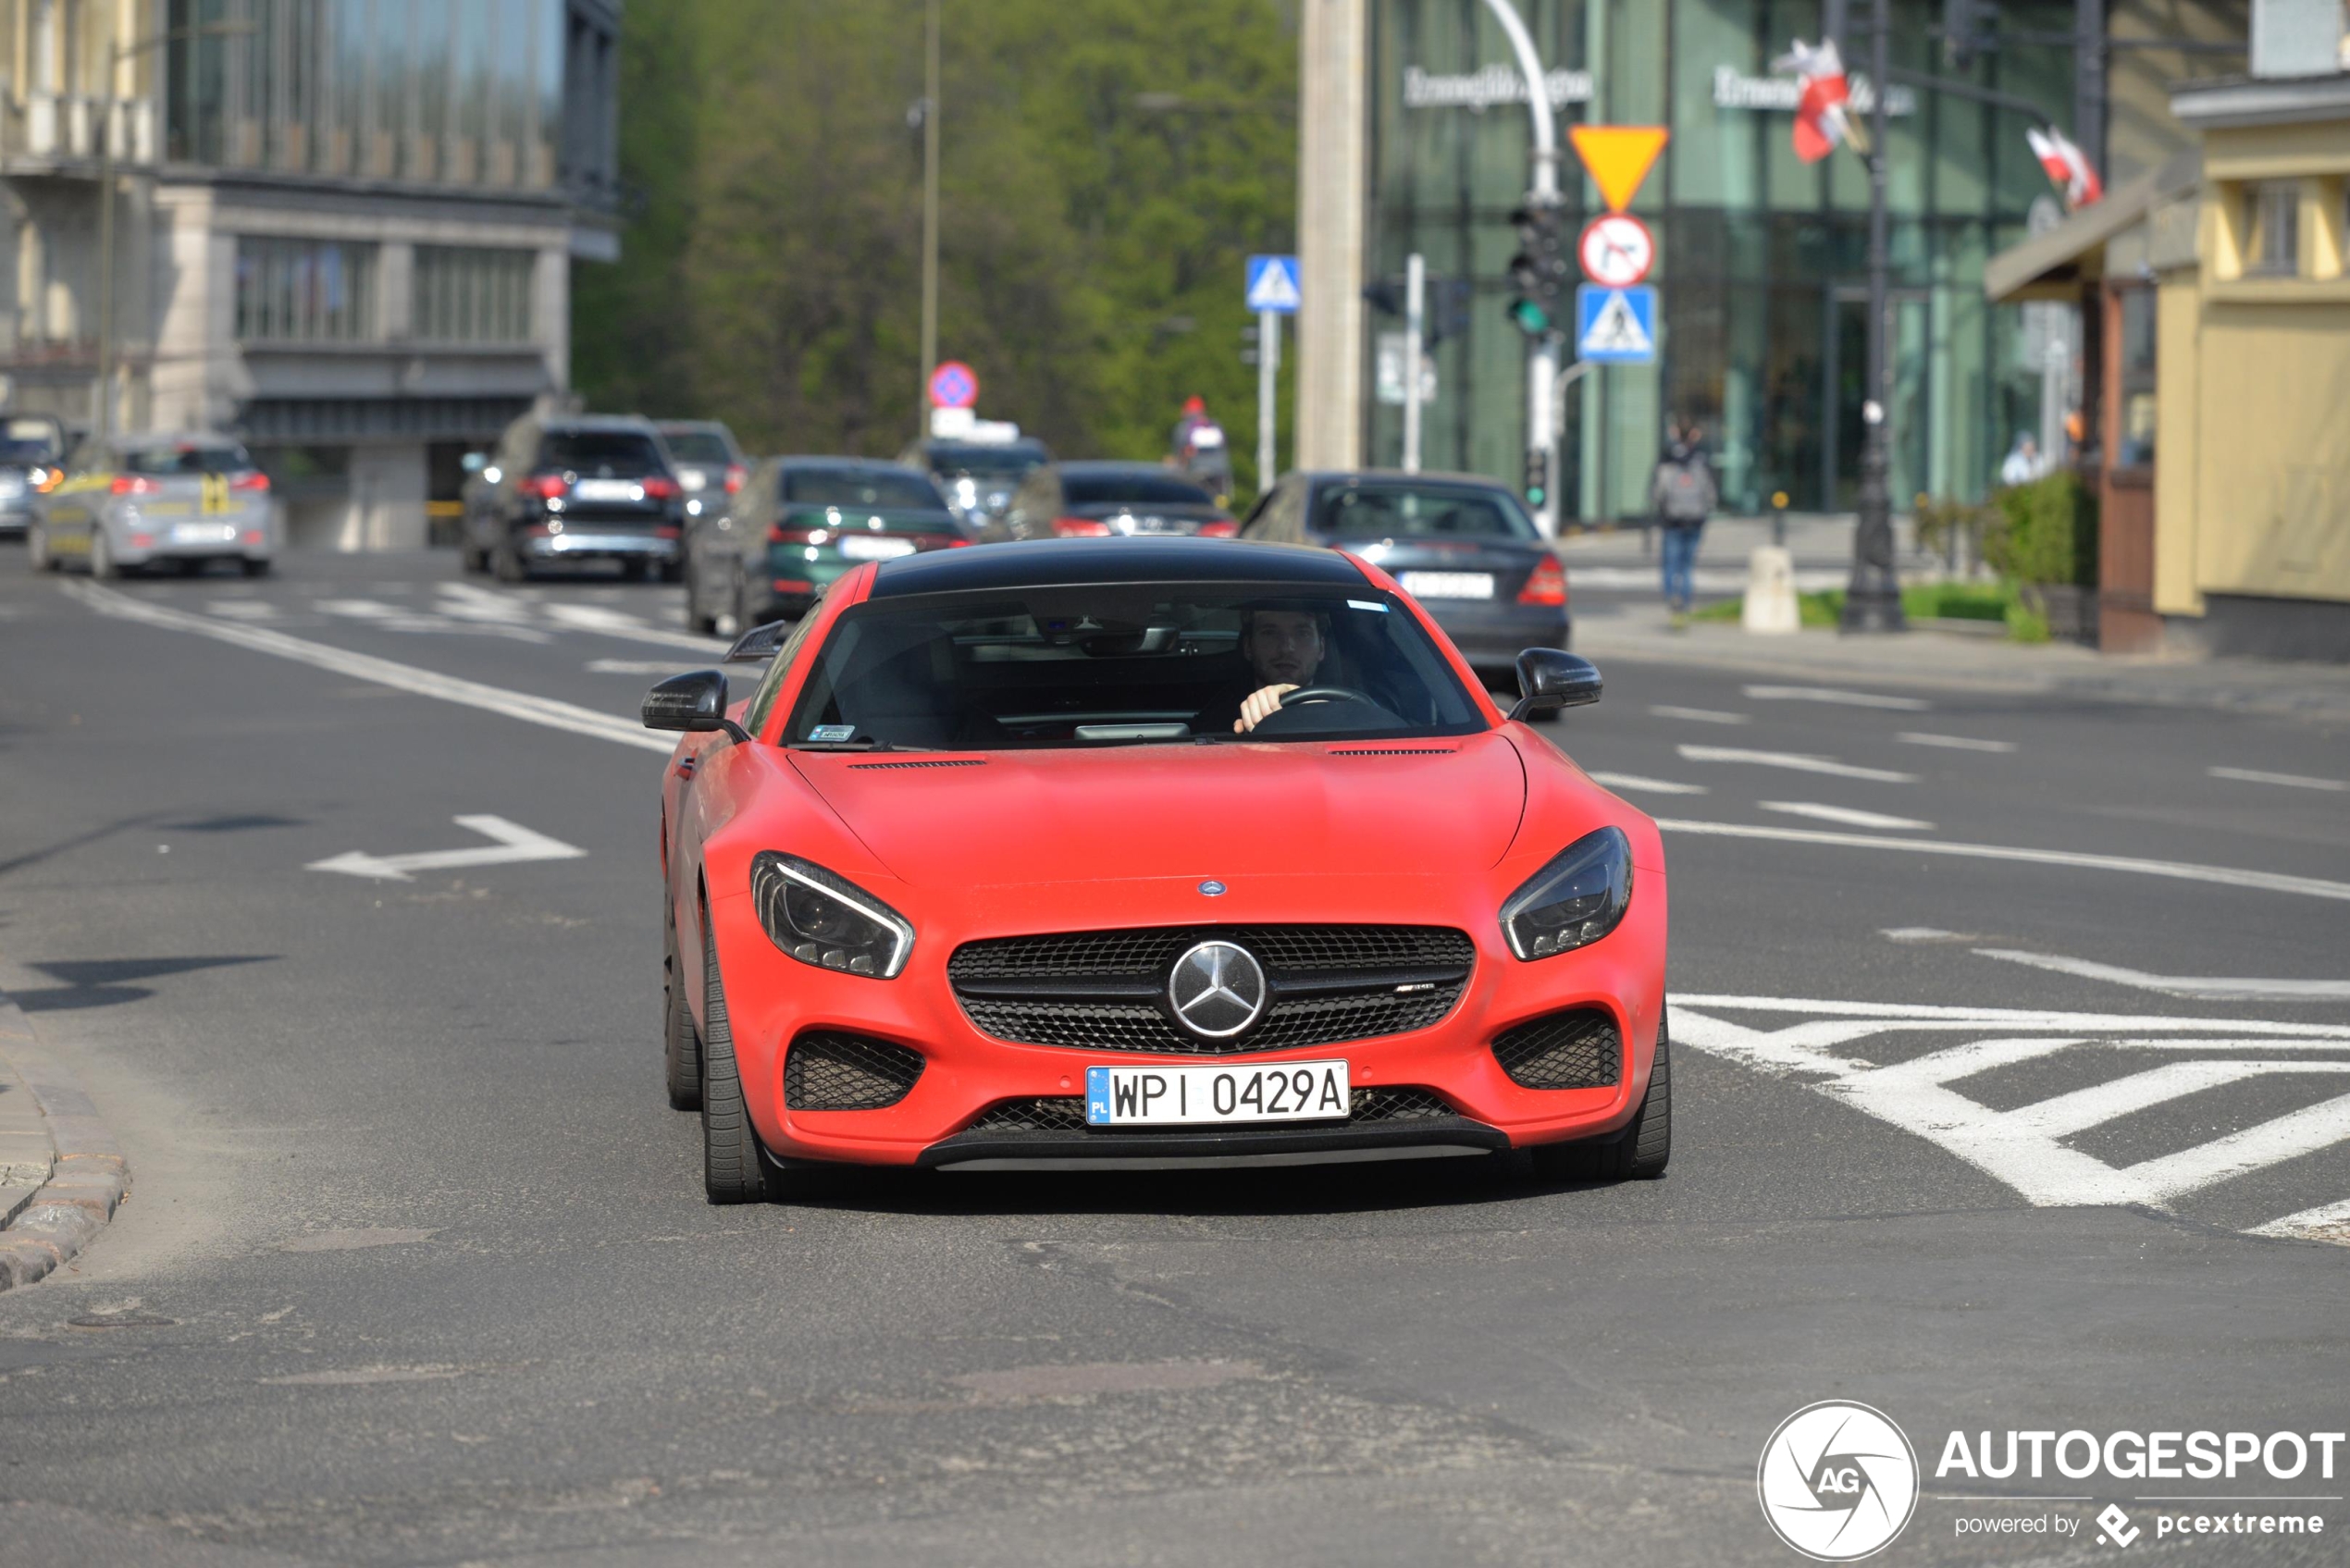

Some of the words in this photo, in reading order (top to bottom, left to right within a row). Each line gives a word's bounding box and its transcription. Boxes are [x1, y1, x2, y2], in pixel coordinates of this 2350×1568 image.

[1091, 1101, 1107, 1115] PL
[1113, 1073, 1187, 1117] WPI
[1213, 1068, 1342, 1117] 0429A
